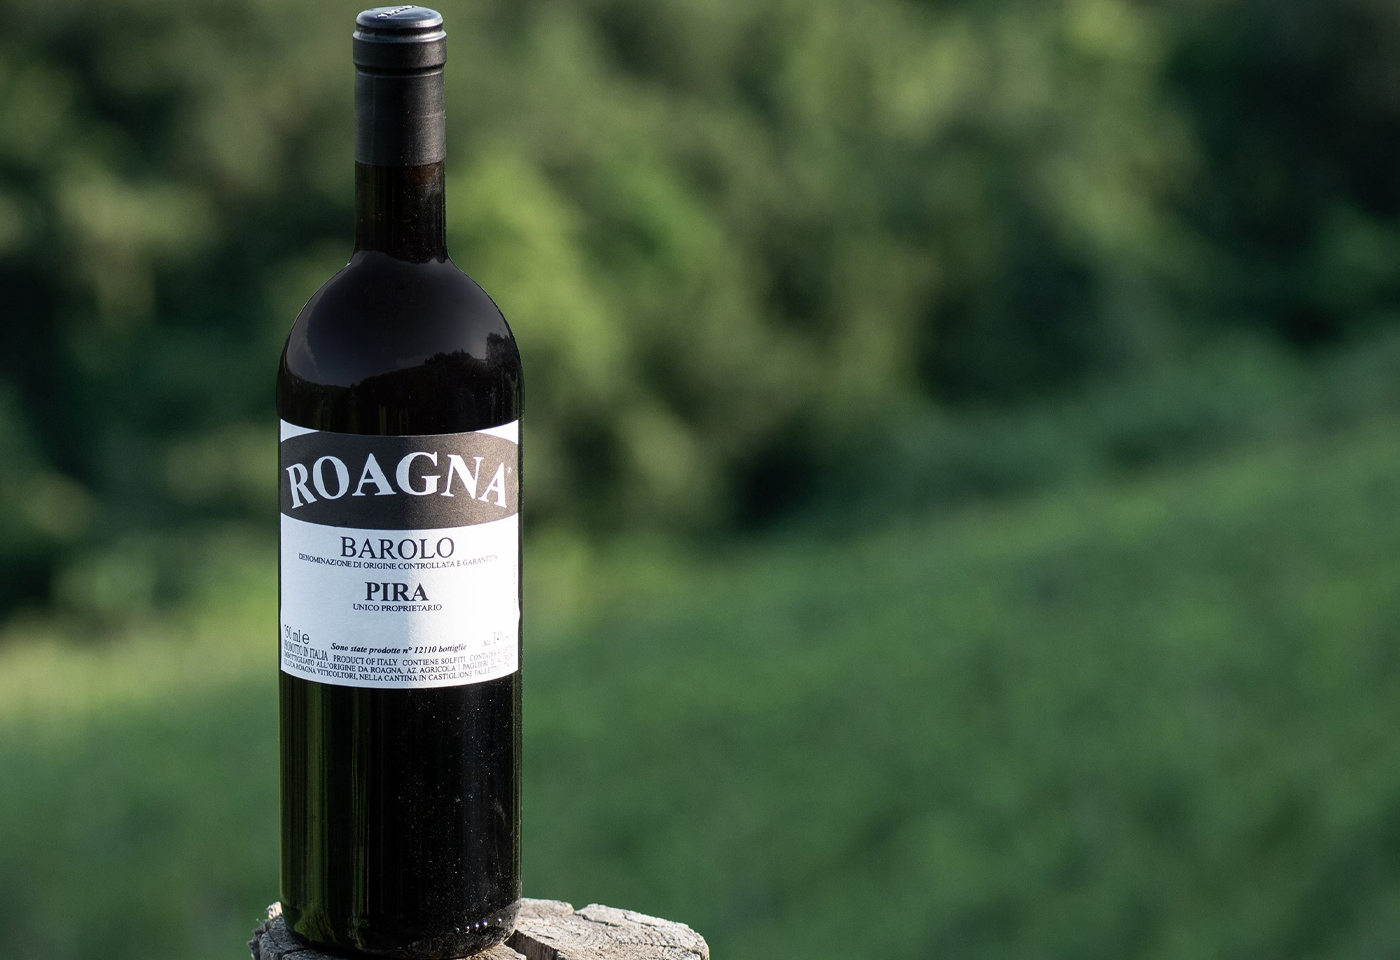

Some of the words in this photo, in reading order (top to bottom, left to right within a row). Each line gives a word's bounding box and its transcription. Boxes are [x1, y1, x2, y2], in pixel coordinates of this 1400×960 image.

[286, 452, 507, 509] ROAGNA
[341, 536, 454, 560] BAROLO
[298, 553, 352, 568] DENOMINAZIONE
[353, 561, 362, 569] DI
[363, 562, 396, 570] ORIGINE
[398, 561, 455, 570] CONTROLLATA
[364, 582, 429, 602] PIRA
[353, 603, 380, 612] UNICO
[381, 604, 443, 612] PROPRIETARIO
[309, 647, 328, 661] ITALIA
[333, 654, 365, 665] PRODUCT
[365, 657, 376, 666] OF
[377, 658, 398, 666] ITALY
[402, 658, 439, 667] CONTIENE
[331, 642, 349, 651] Sono
[350, 645, 367, 653] state
[368, 646, 401, 655] prodotte
[414, 645, 437, 654] 12110
[438, 643, 467, 653] bottiglie
[359, 673, 383, 682] NELLA
[384, 674, 417, 682] CANTINA
